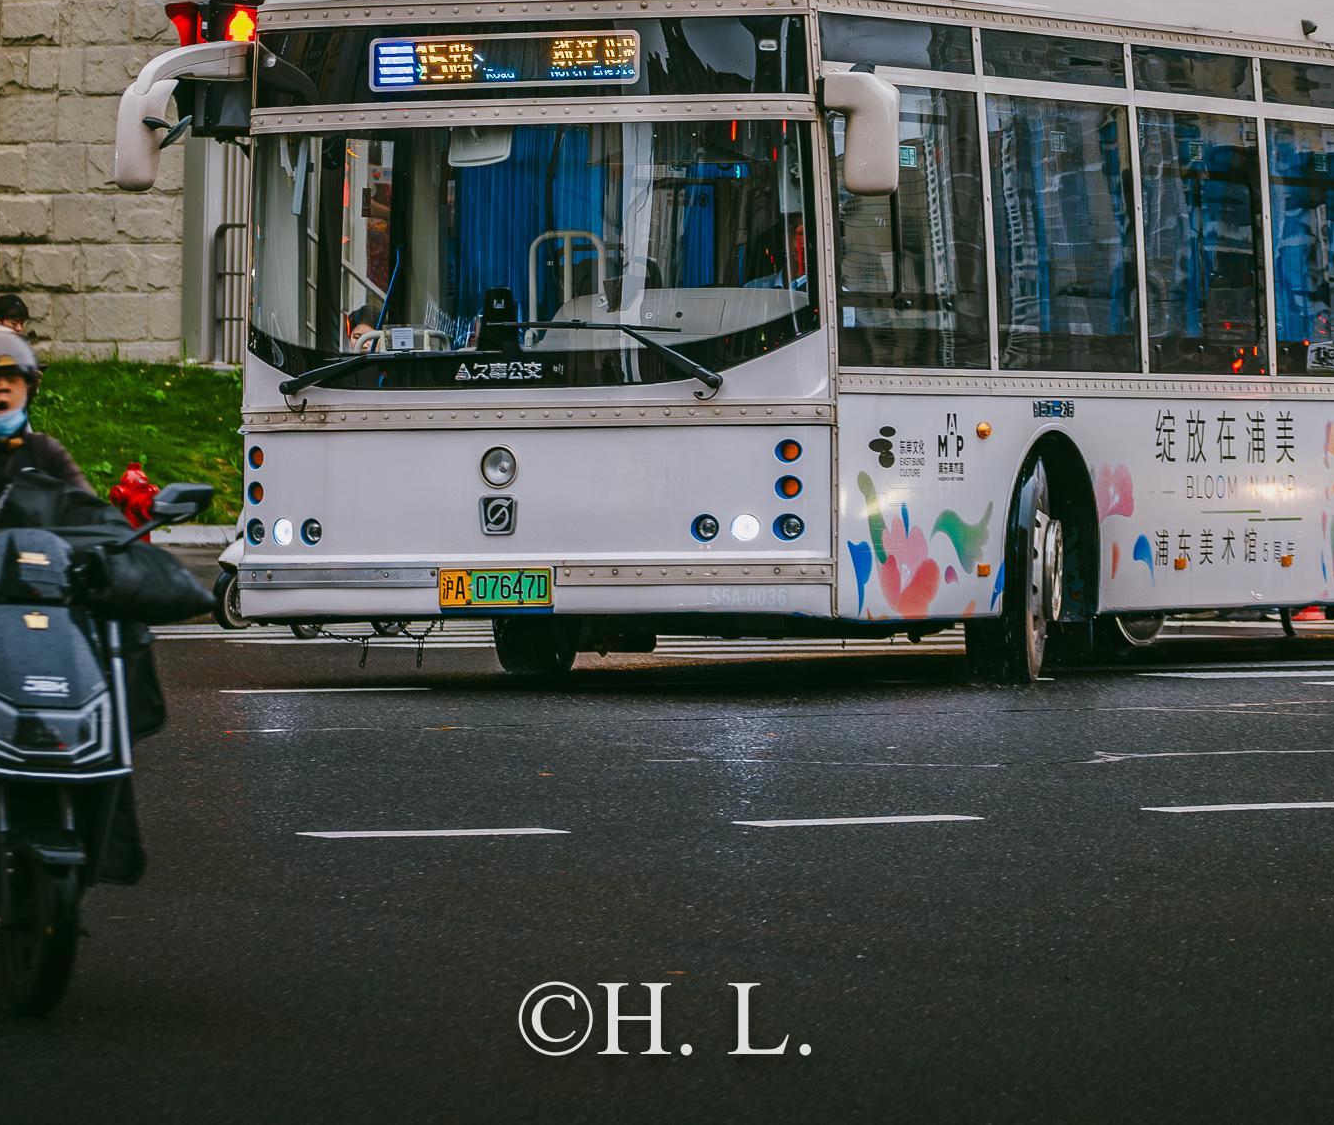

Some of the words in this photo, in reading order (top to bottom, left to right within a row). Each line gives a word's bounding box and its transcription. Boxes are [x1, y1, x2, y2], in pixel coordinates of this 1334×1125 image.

[1155, 410, 1296, 463] 绽放在浦美
[1187, 475, 1238, 499] BLOOM
